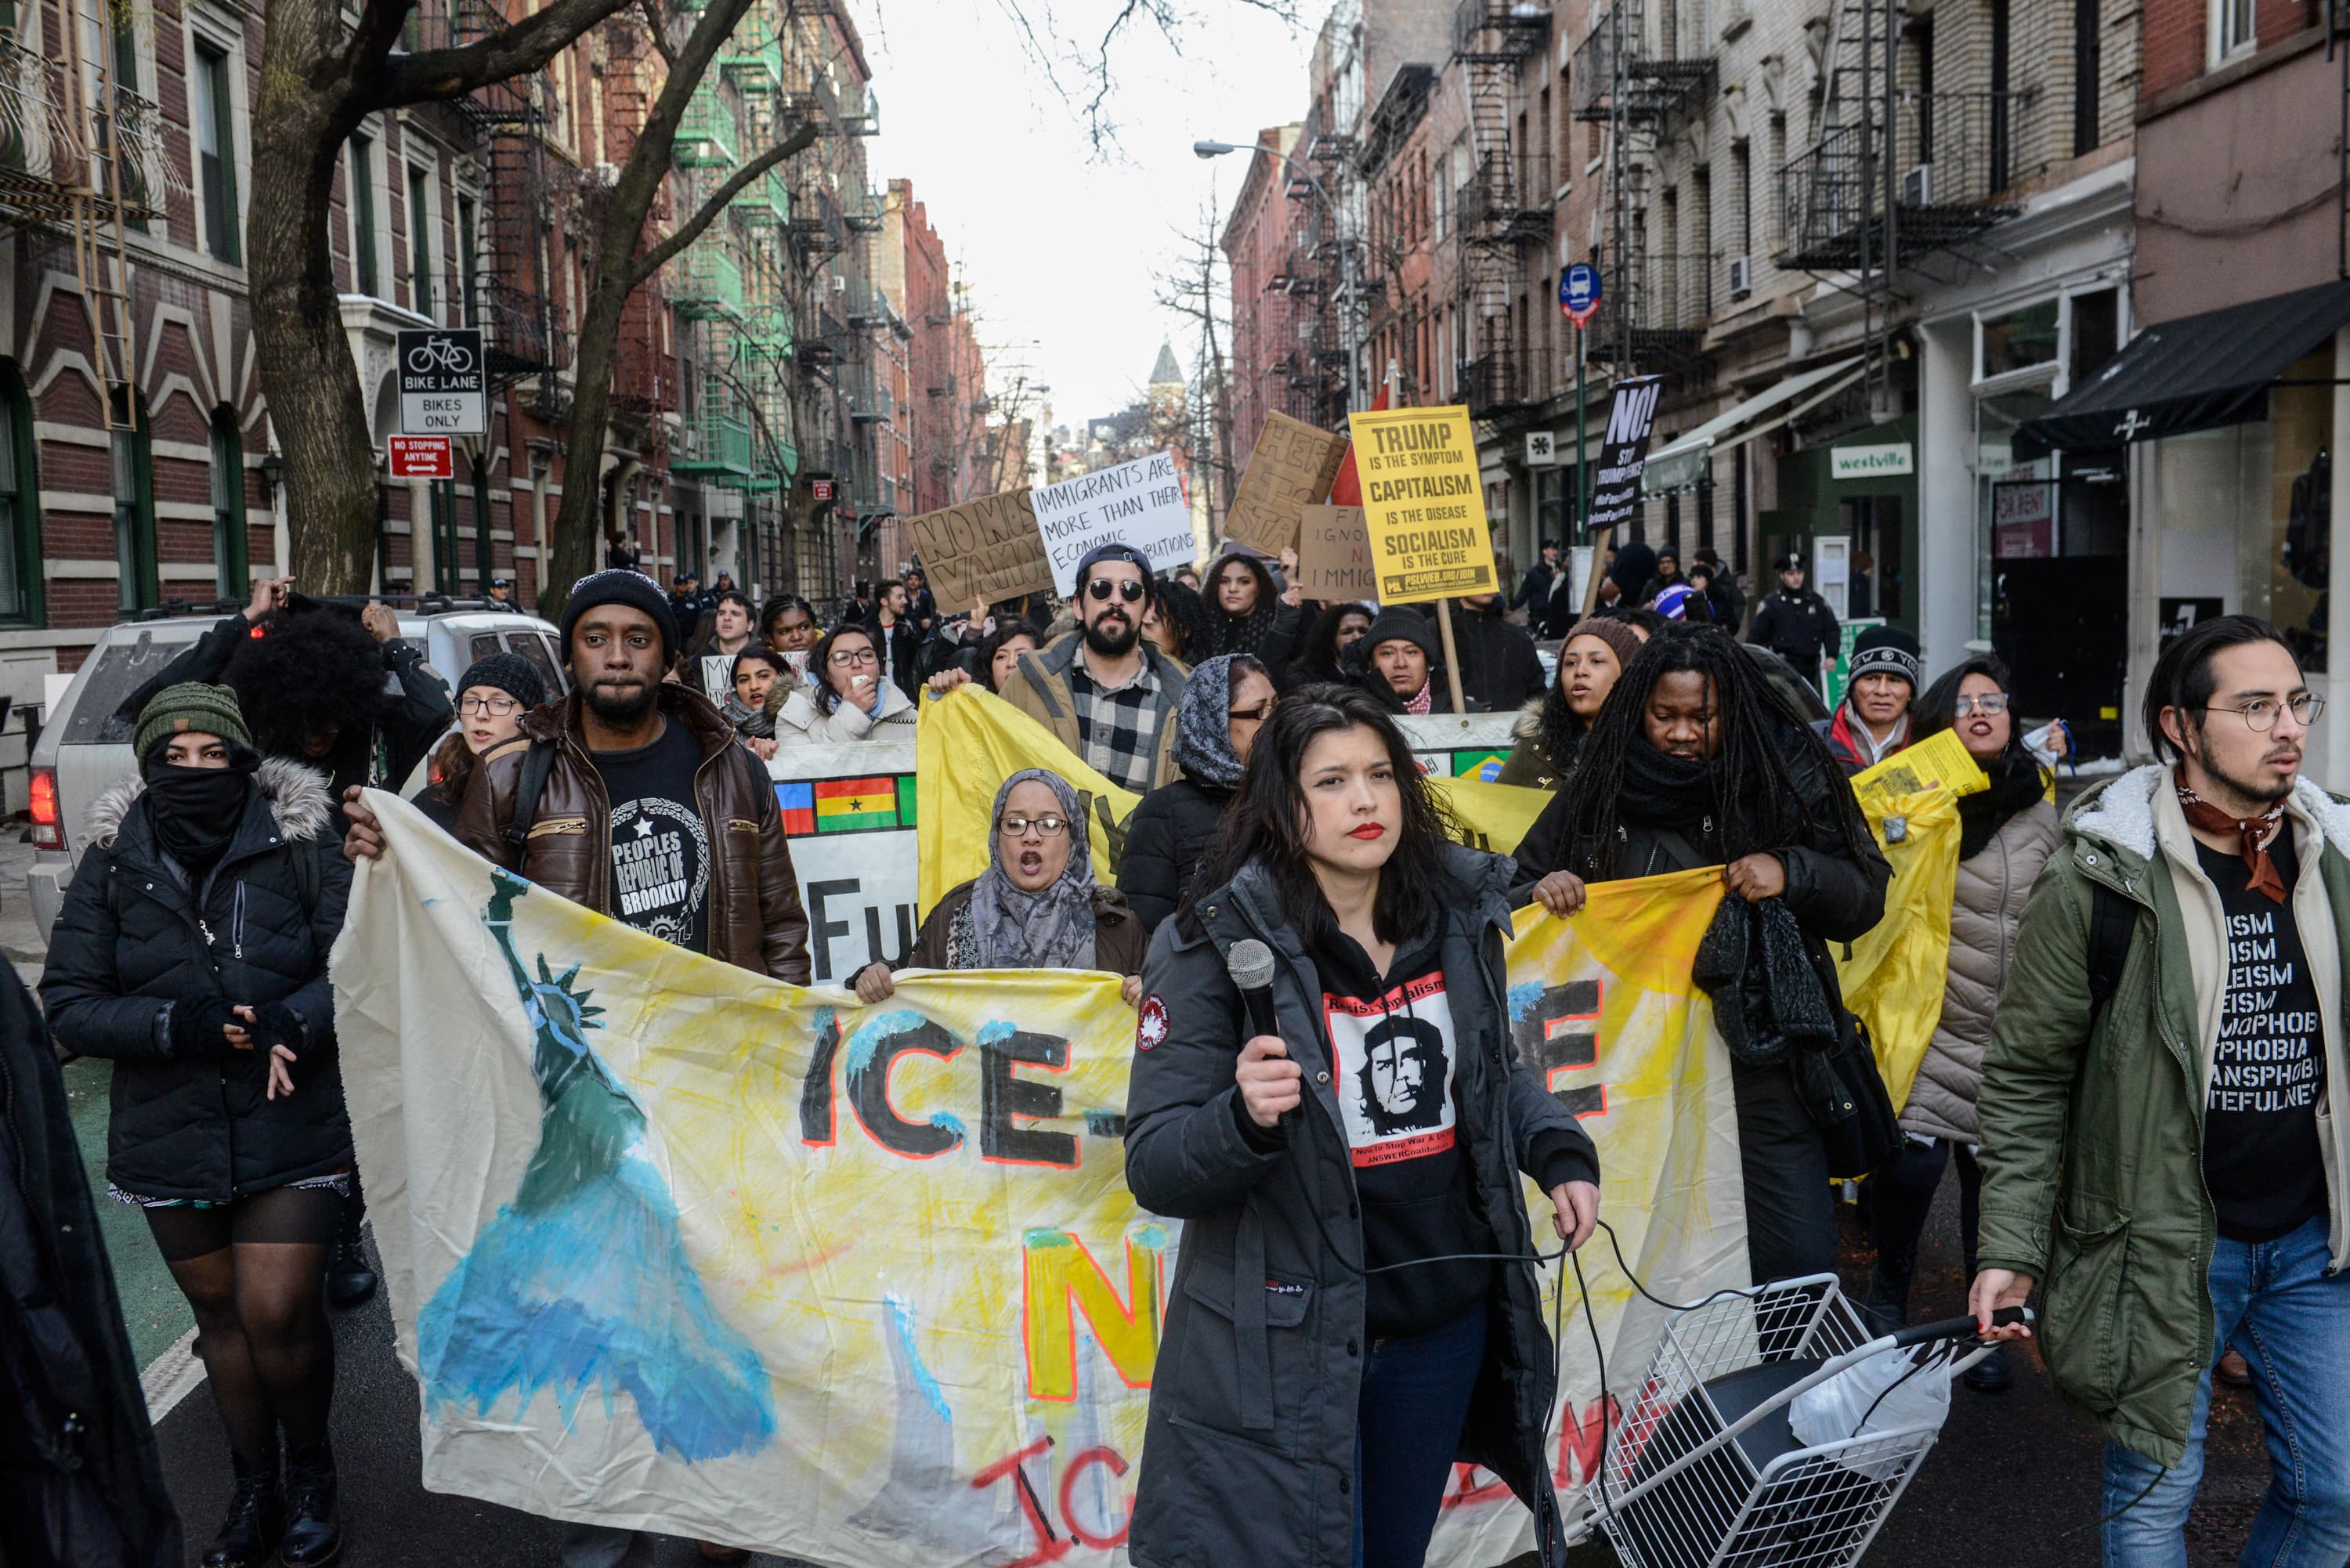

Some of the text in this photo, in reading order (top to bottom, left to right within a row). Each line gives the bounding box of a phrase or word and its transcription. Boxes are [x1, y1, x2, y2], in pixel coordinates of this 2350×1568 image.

[405, 375, 478, 389] BIKE LANE
[423, 399, 461, 411] BIKES
[1606, 383, 1660, 445] NO!
[425, 415, 461, 427] ONLY
[394, 440, 446, 450] NO STOPPING
[1256, 419, 1345, 481] HERE
[1372, 423, 1452, 454] TRUMP
[404, 452, 438, 461] ANYTIME
[1369, 450, 1463, 470] IS THE SYMPTOM
[1838, 453, 1906, 469] westville
[1036, 456, 1175, 514] IMMIGRANTS ARE
[1369, 474, 1473, 503] CAPITALISM
[1044, 486, 1184, 541] MORE THAN THEIR
[1224, 497, 1301, 548] STA
[1386, 505, 1467, 526] IS THE DISEASE
[913, 510, 976, 564] NO
[1052, 529, 1126, 570] ECONOMIC
[1142, 533, 1195, 560] IBUTIONS
[1385, 527, 1477, 556] SOCIALISM
[1402, 550, 1467, 569] IS THE CURE
[1312, 569, 1376, 587] IMMIG
[1405, 568, 1476, 586] PSLWEB.ORG/JOIN
[706, 657, 732, 689] MY
[1851, 652, 1874, 670] NEW
[612, 831, 682, 865] PEOPLES
[616, 851, 684, 894] REPUBLIC OF
[2225, 911, 2274, 938] ISM
[2229, 938, 2276, 964] ISM
[2222, 990, 2277, 1014] EISM
[2220, 1011, 2320, 1039] MOPHOB
[2215, 1037, 2308, 1061] PHOBIA
[2211, 1054, 2325, 1088] ANSPHOBI
[1367, 1143, 1448, 1164] ANSWERCoalition.
[1386, 1142, 1405, 1151] Stop
